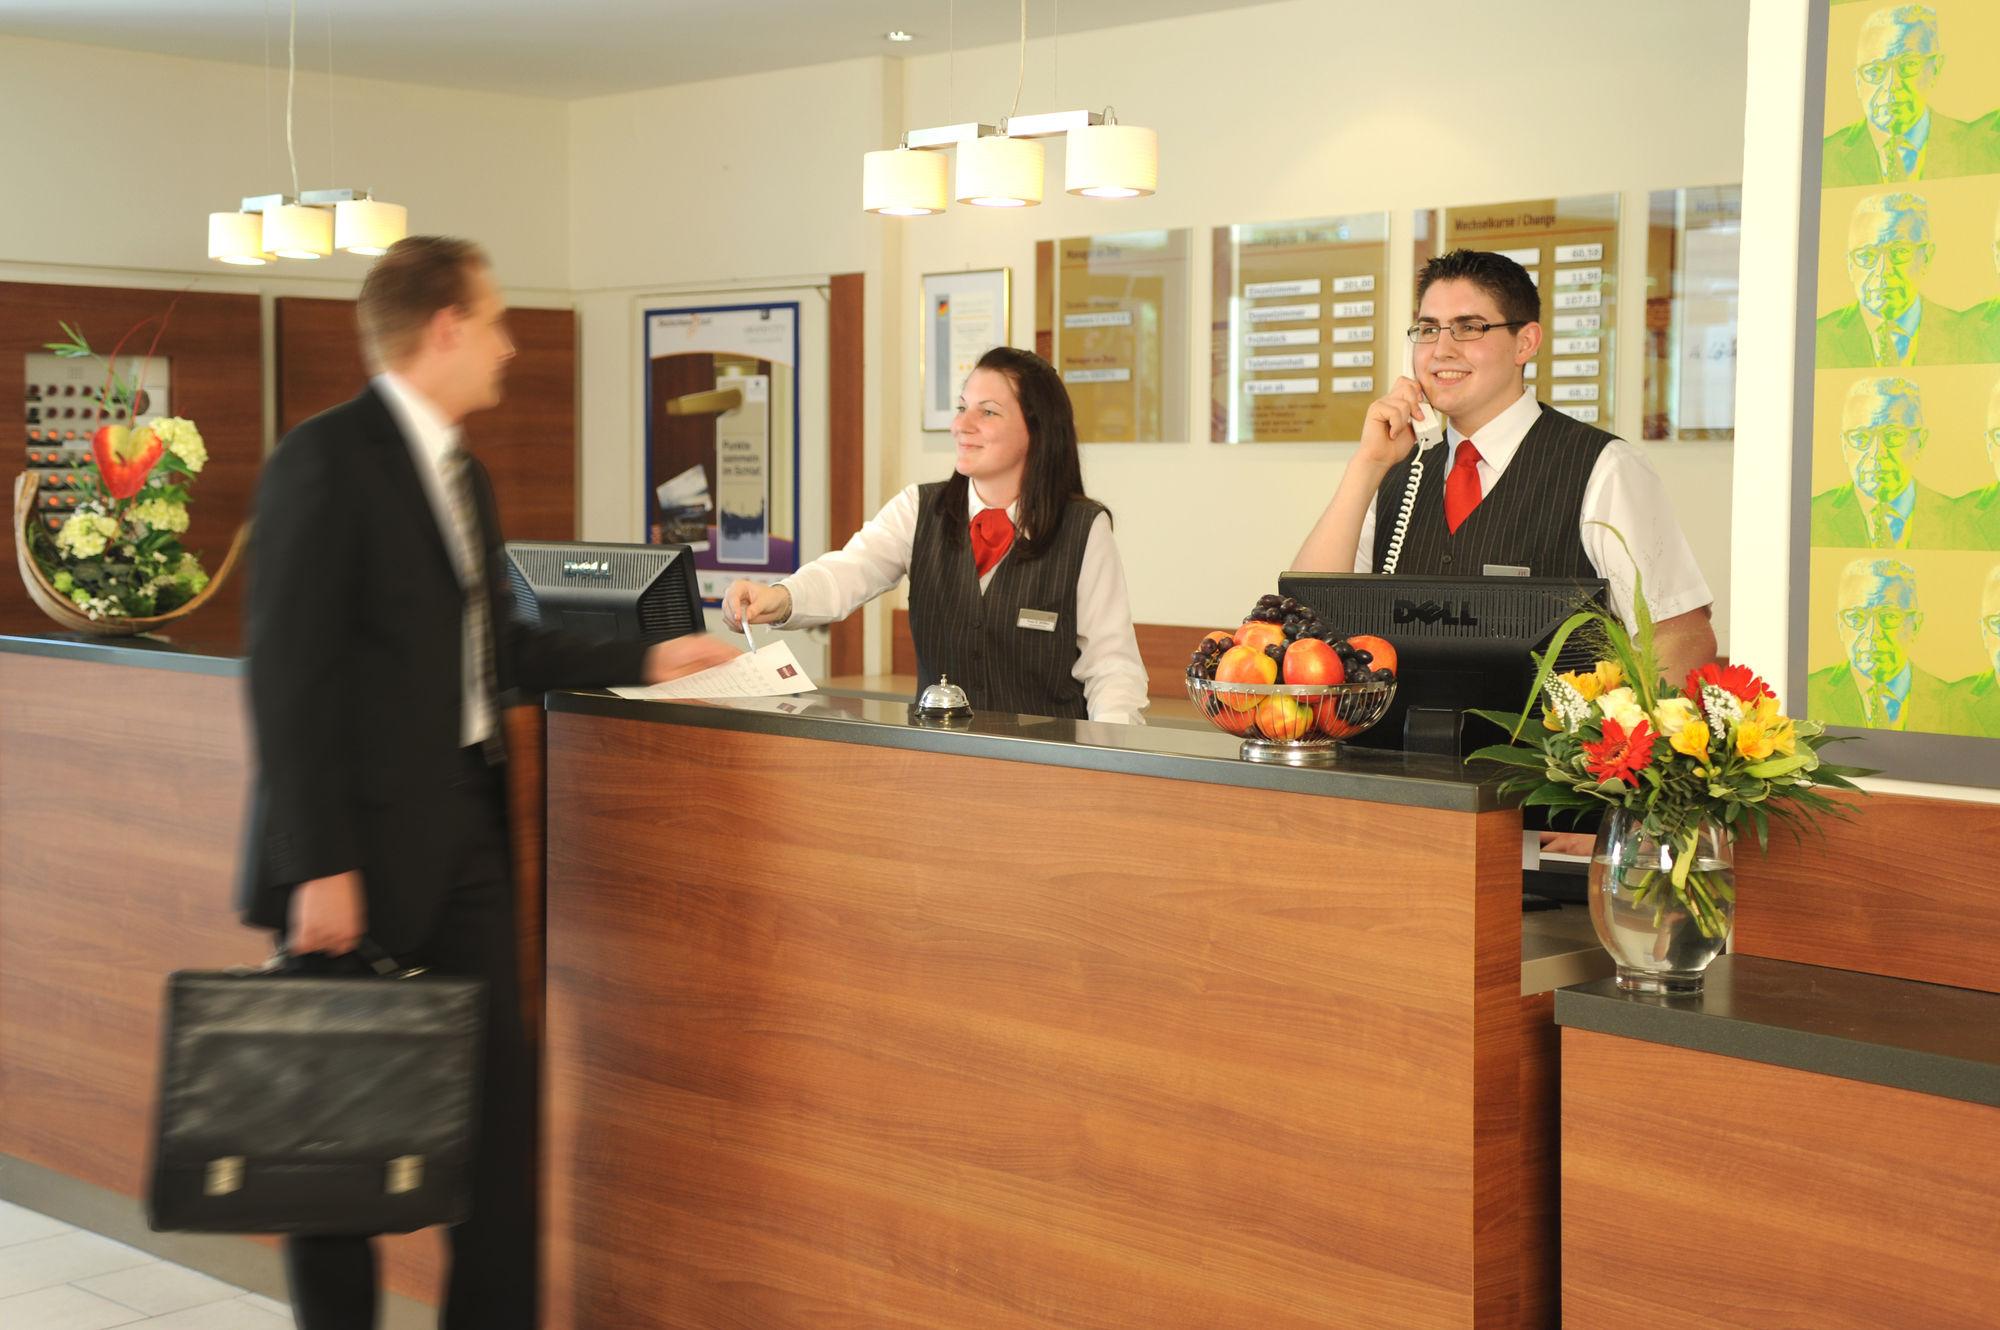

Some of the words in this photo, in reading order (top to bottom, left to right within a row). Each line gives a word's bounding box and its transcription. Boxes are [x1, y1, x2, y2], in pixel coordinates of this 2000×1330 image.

[1455, 215, 1515, 232] Wechselkurse
[1523, 212, 1556, 229] Change
[1393, 600, 1478, 625] DELL
